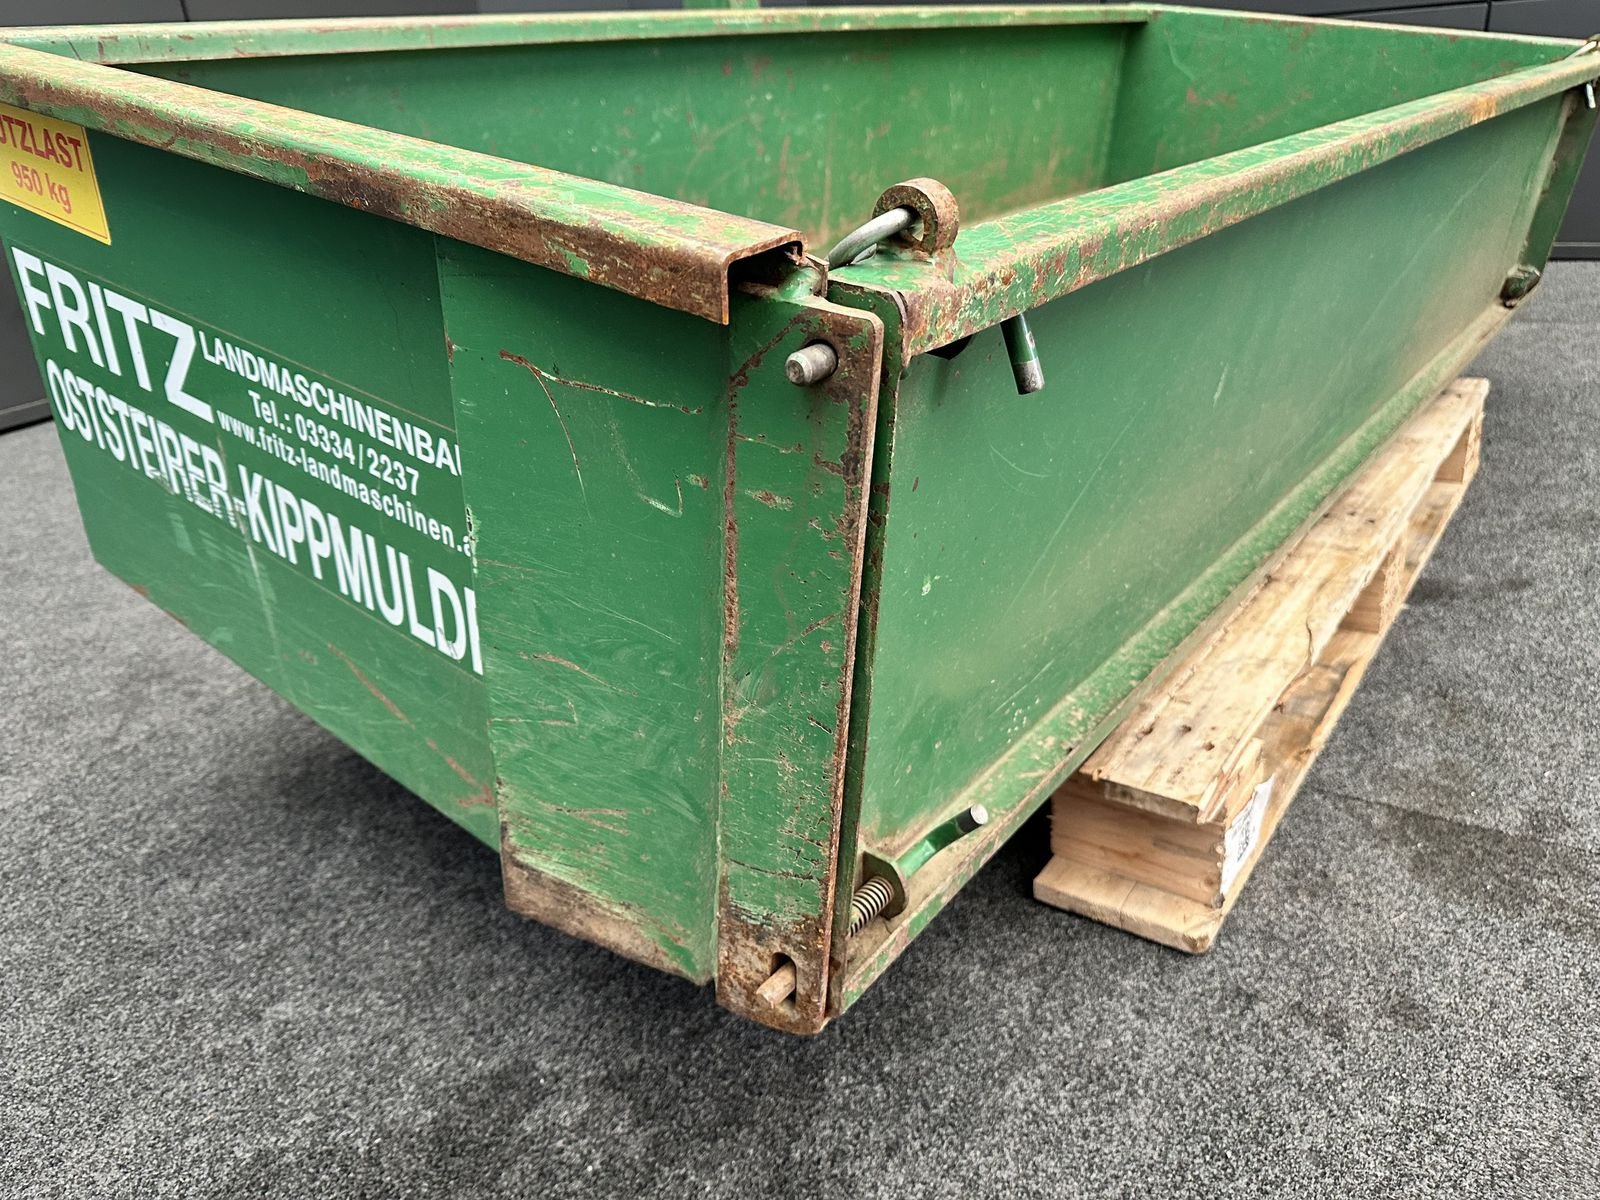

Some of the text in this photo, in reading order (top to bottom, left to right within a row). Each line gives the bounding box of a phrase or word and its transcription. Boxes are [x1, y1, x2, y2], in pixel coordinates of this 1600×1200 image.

[11, 161, 72, 214] 950 kg
[12, 246, 214, 423] FRITZ
[248, 390, 292, 433] Tel.:
